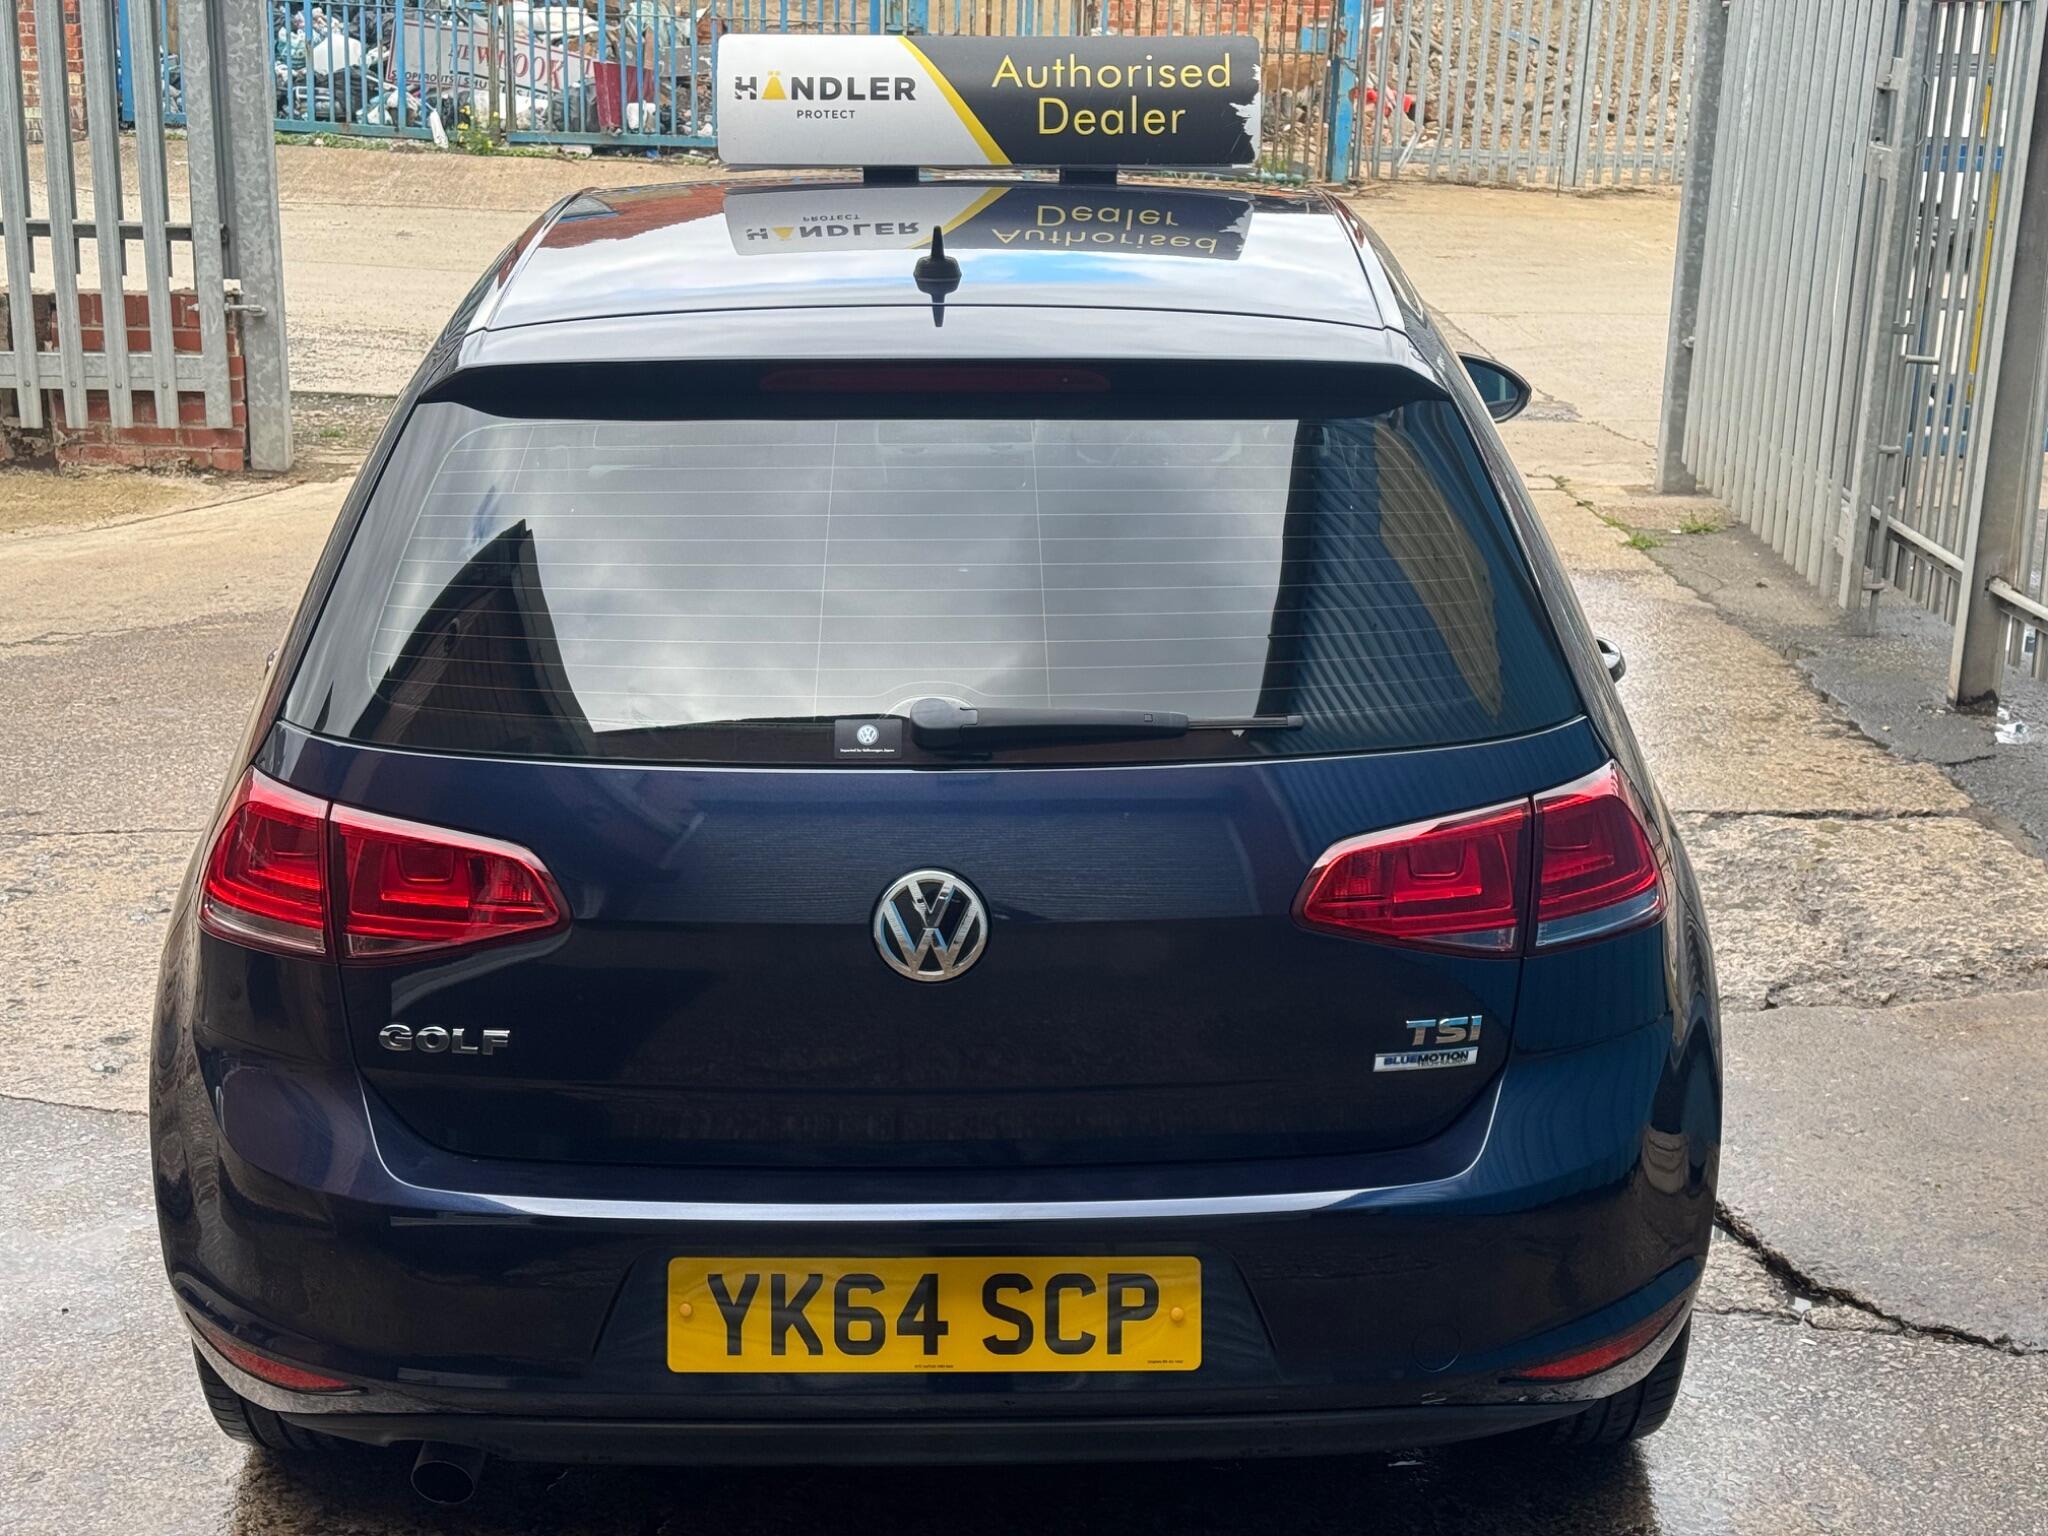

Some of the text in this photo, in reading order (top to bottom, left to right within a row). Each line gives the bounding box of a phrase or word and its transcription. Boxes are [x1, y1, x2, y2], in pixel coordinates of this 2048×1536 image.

[990, 52, 1232, 89] Authorised
[796, 109, 856, 120] PROTECT
[1038, 94, 1188, 135] Dealer
[378, 1023, 511, 1055] GOLF
[1405, 1014, 1483, 1046] TSI
[1383, 1050, 1470, 1066] BLUEMOTION
[706, 1272, 1161, 1357] YK64 SCP
